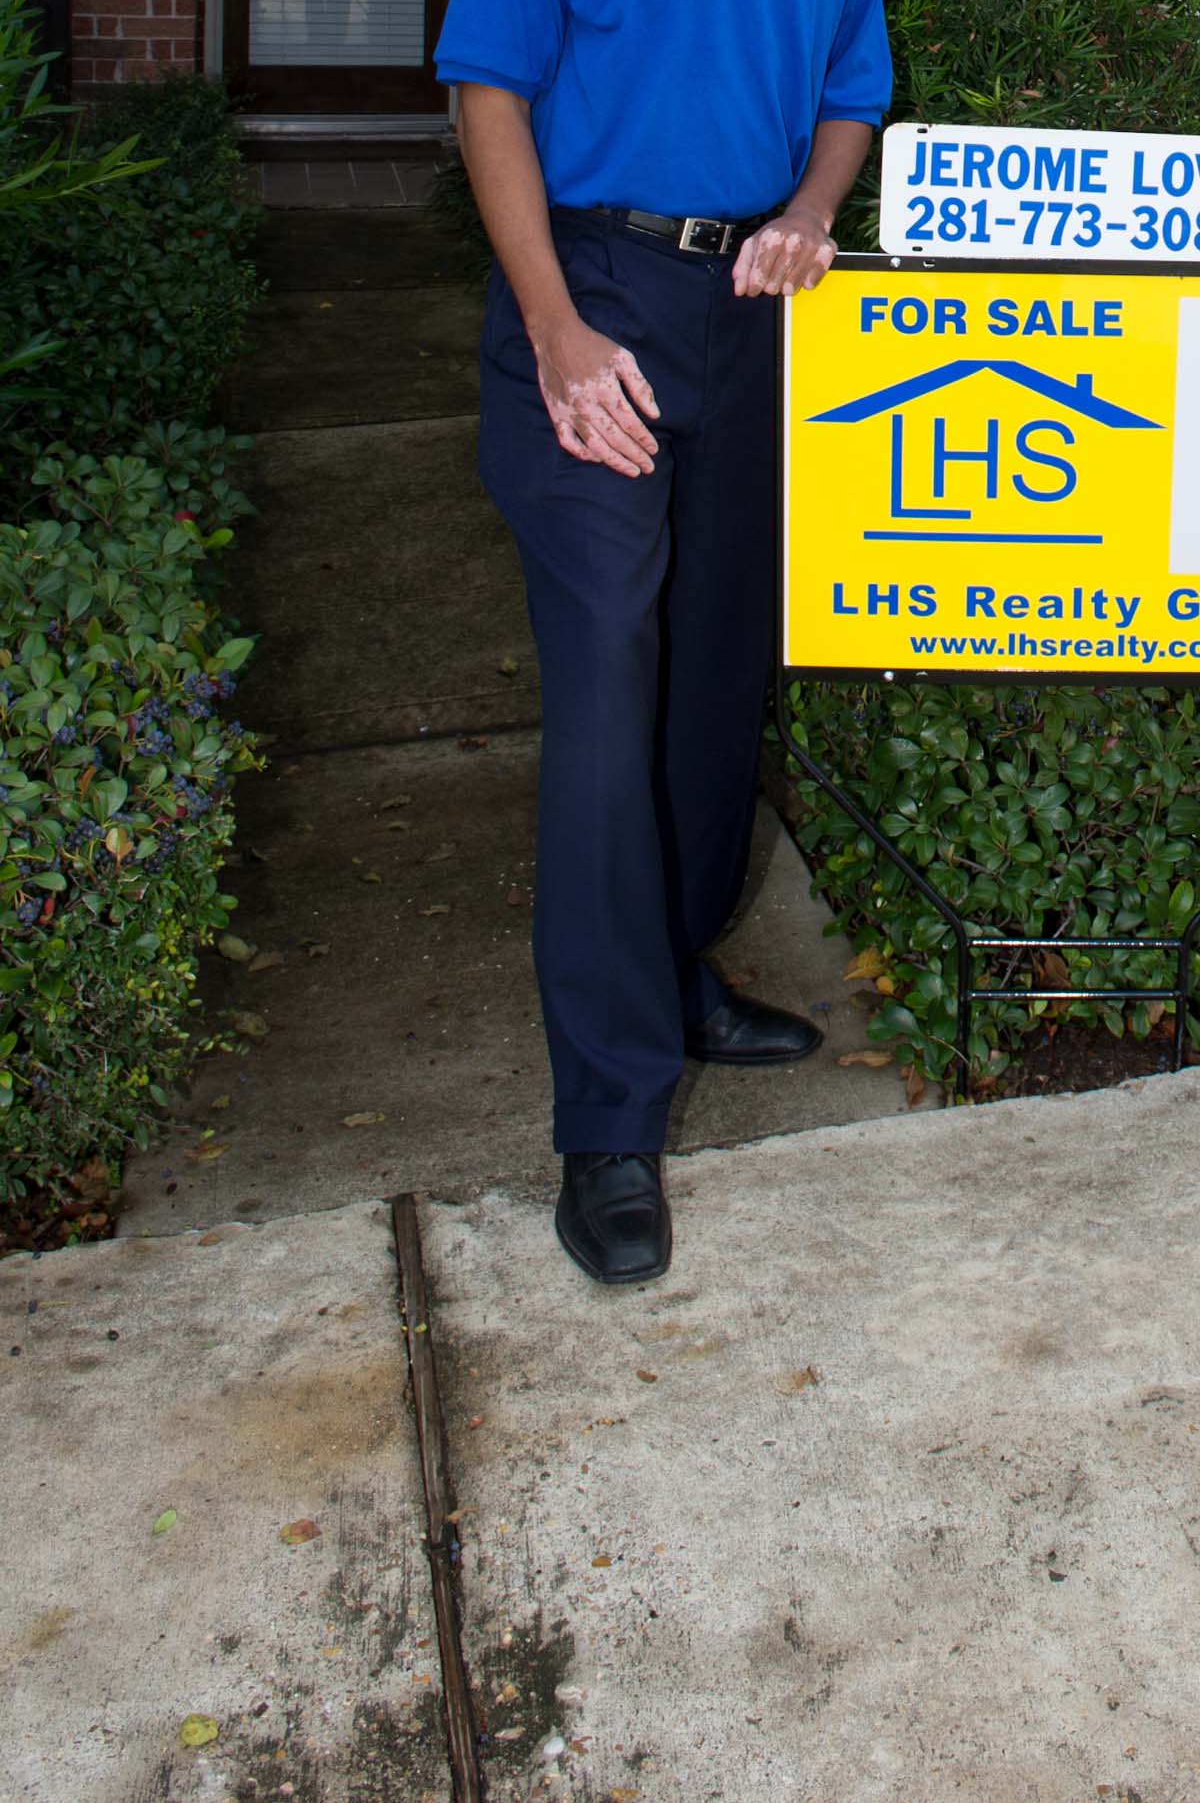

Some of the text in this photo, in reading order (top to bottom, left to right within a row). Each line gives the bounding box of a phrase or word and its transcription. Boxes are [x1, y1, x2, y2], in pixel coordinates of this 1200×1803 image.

[906, 140, 1109, 194] JEROME
[860, 296, 1123, 337] FOR SALE
[891, 414, 1078, 519] LHS
[833, 583, 938, 617] LHS
[966, 586, 1141, 628] Realty
